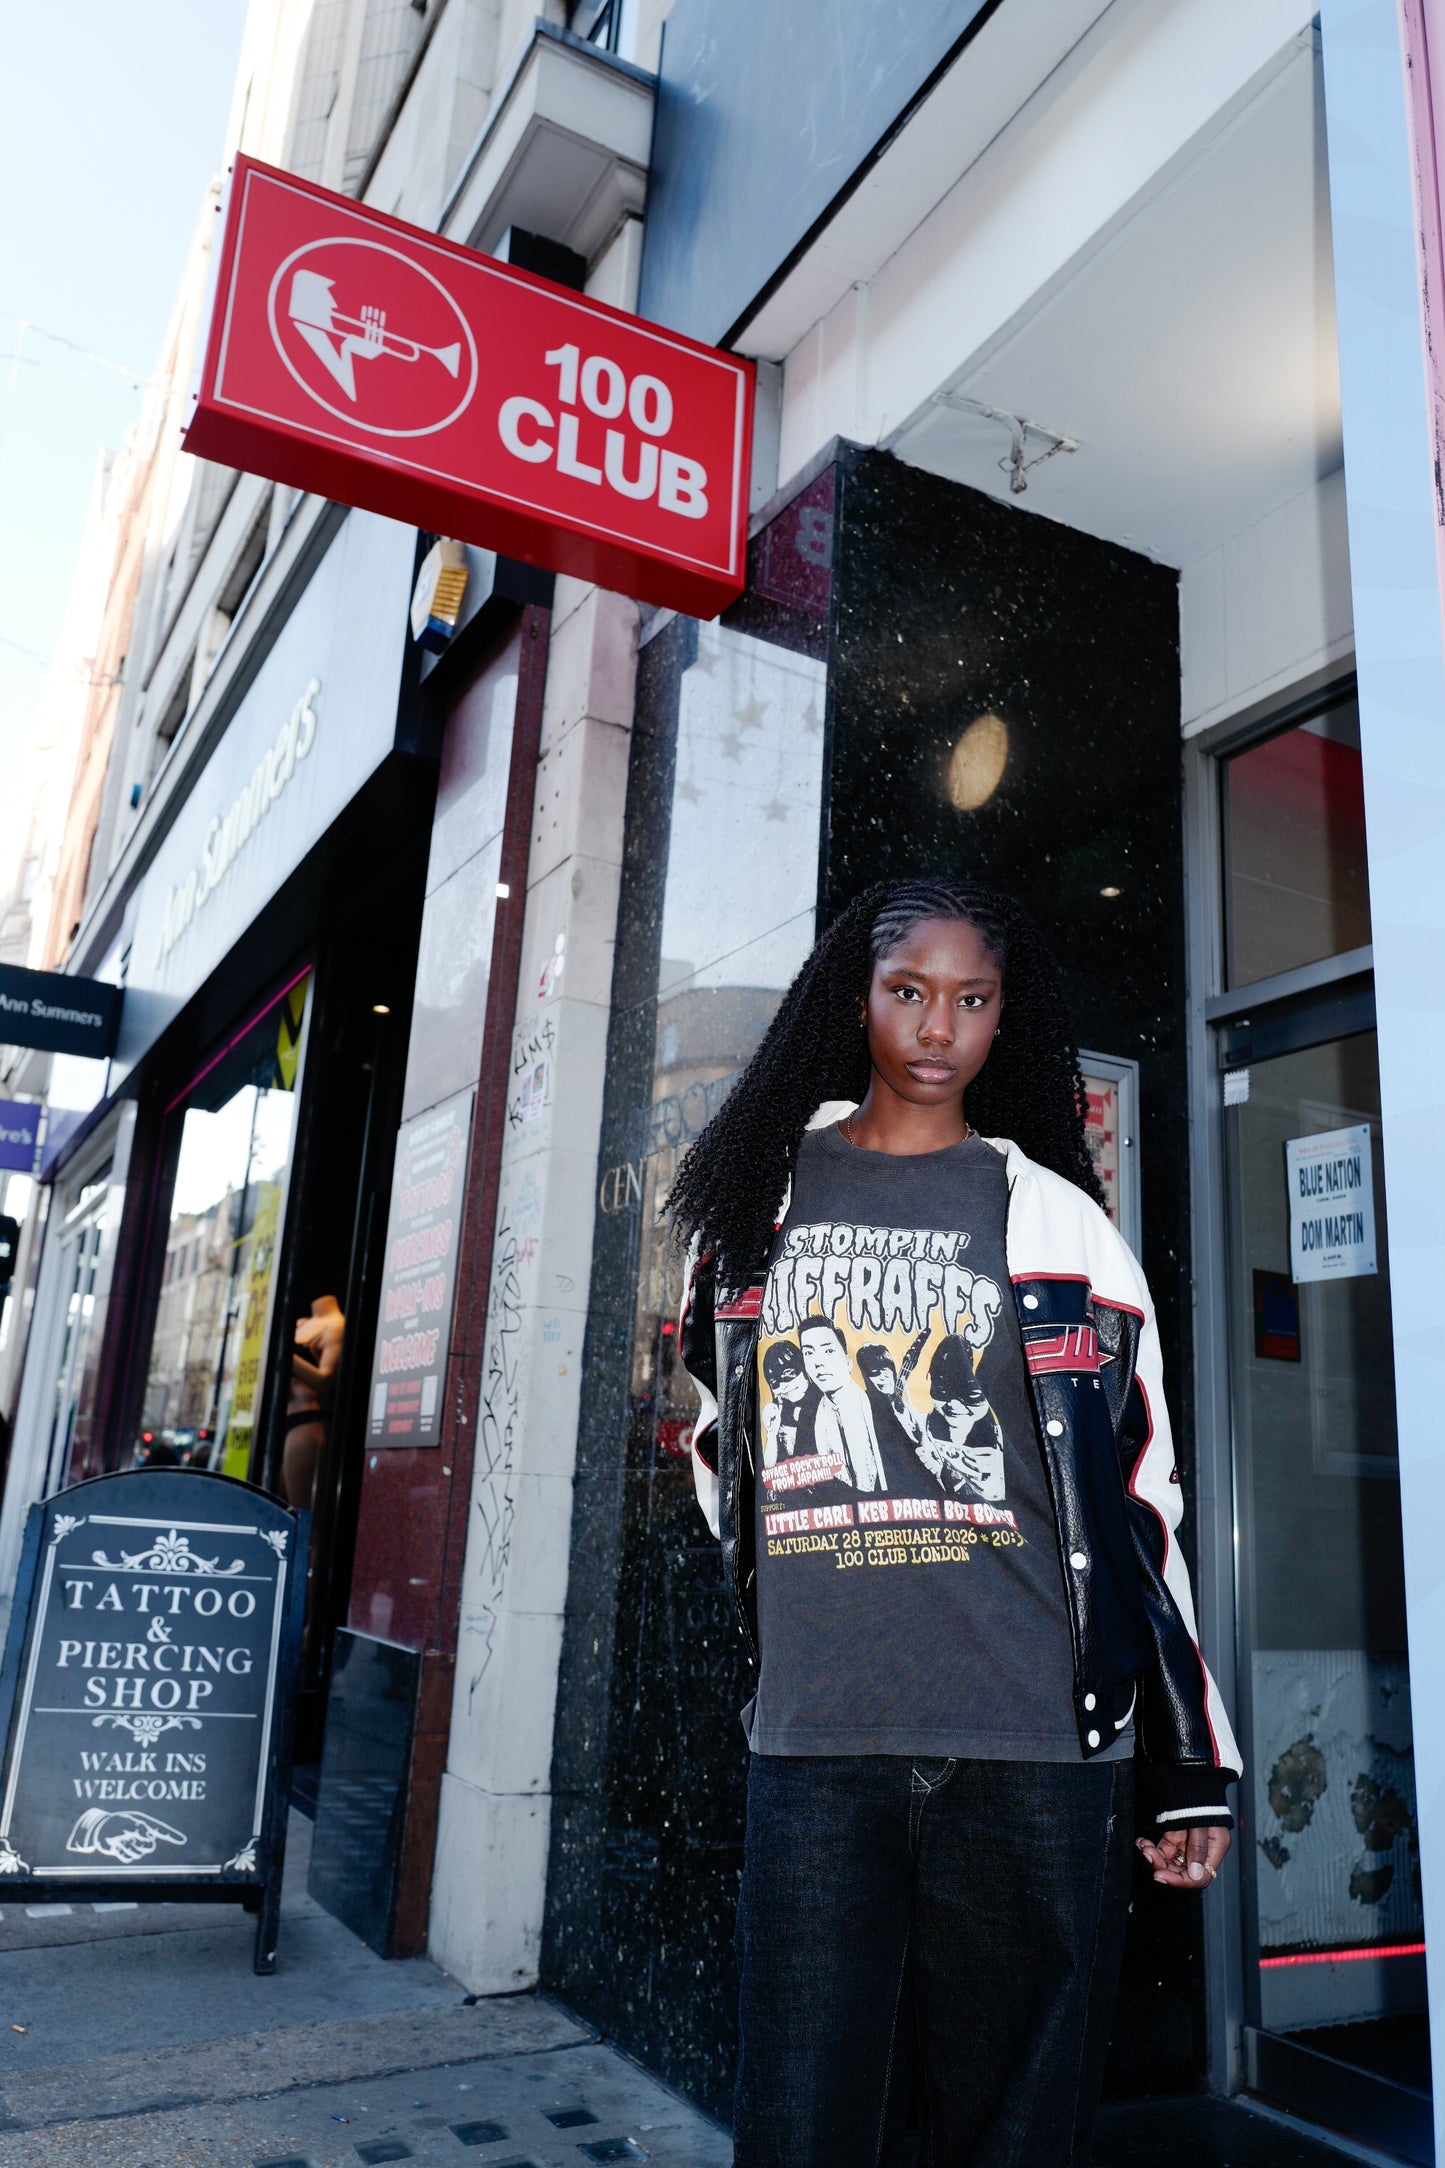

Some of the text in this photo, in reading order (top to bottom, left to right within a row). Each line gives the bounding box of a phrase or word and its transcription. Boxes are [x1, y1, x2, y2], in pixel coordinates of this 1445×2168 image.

[545, 343, 673, 437] 100
[497, 395, 709, 520] CLUB
[0, 993, 103, 1027] Ann Summers
[1299, 1156, 1361, 1197] BLUE NATION
[784, 1223, 970, 1263] STOMPIN'
[1301, 1212, 1364, 1251] DOM MARTIN
[761, 1464, 788, 1482] SAVAGE
[772, 1477, 795, 1491] FROM
[765, 1510, 809, 1536] LITTLE
[813, 1504, 852, 1530] CARL
[858, 1501, 888, 1523] KEB
[892, 1498, 939, 1520] DARGE
[944, 1500, 971, 1521] BOZ
[767, 1533, 839, 1556] SATURDAY
[842, 1530, 861, 1549] 28
[865, 1527, 941, 1548] FEBRUARY
[944, 1527, 977, 1546] 2026
[836, 1545, 970, 1568] 100 CLUB LONDON
[64, 1580, 257, 1618] TATTOO
[147, 1615, 172, 1643] &
[56, 1639, 254, 1675] PIERCING
[83, 1677, 214, 1710] SHOP
[80, 1751, 207, 1774] WALK INS
[73, 1778, 206, 1801] WELCOME
